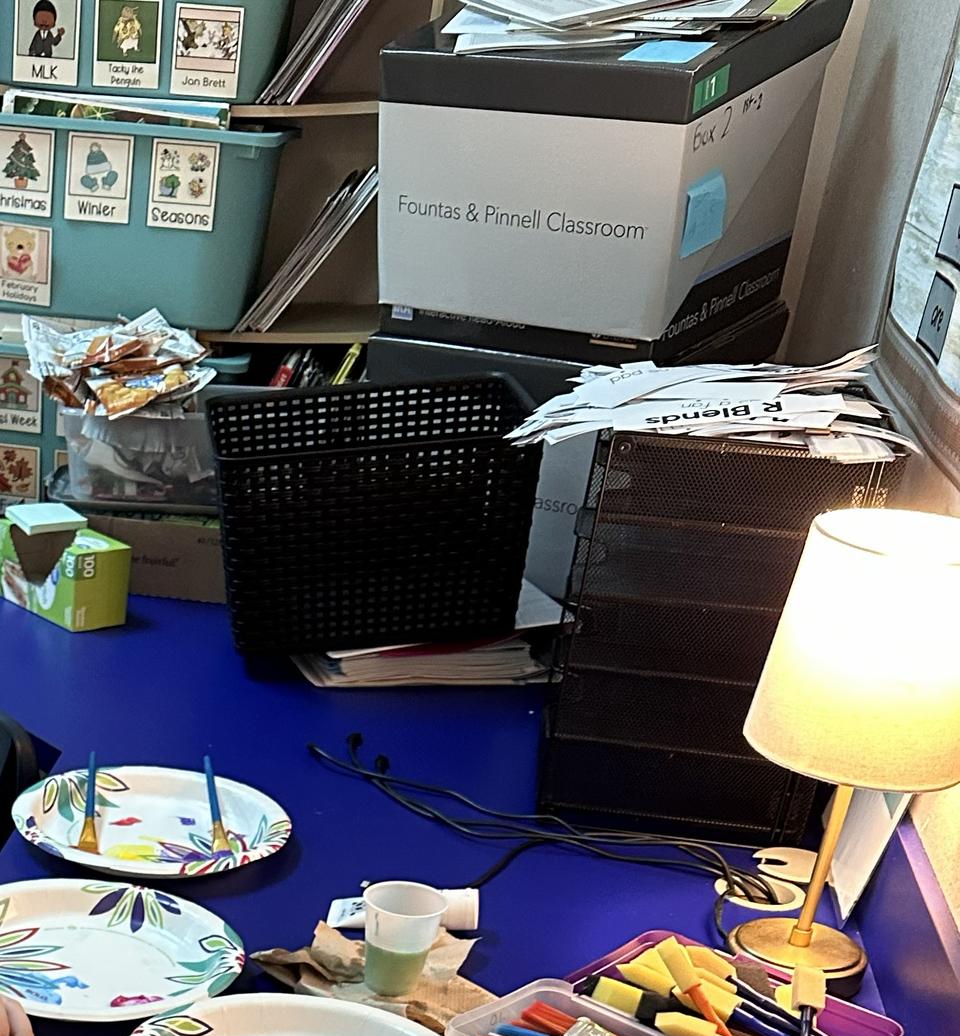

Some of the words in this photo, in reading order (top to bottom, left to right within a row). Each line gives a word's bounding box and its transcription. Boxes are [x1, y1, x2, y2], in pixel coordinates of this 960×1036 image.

[31, 63, 58, 80] MLK
[108, 64, 129, 75] Tacky
[110, 75, 141, 87] Penguin
[182, 76, 200, 87] Jan
[204, 78, 226, 88] Brett
[693, 121, 716, 152] Box
[721, 105, 733, 139] 2
[77, 201, 116, 217] Winter
[151, 207, 210, 226] Seasons
[398, 195, 461, 221] Fountas
[465, 204, 479, 223] &
[484, 205, 541, 230] Pinnell
[1, 279, 39, 293] February
[708, 284, 738, 317] Pinnell
[930, 304, 945, 332] are
[645, 404, 751, 425] Blends
[763, 401, 783, 413] R
[11, 415, 38, 426] Week
[535, 498, 578, 515] assro
[65, 554, 75, 577] 100
[83, 554, 95, 577] 100
